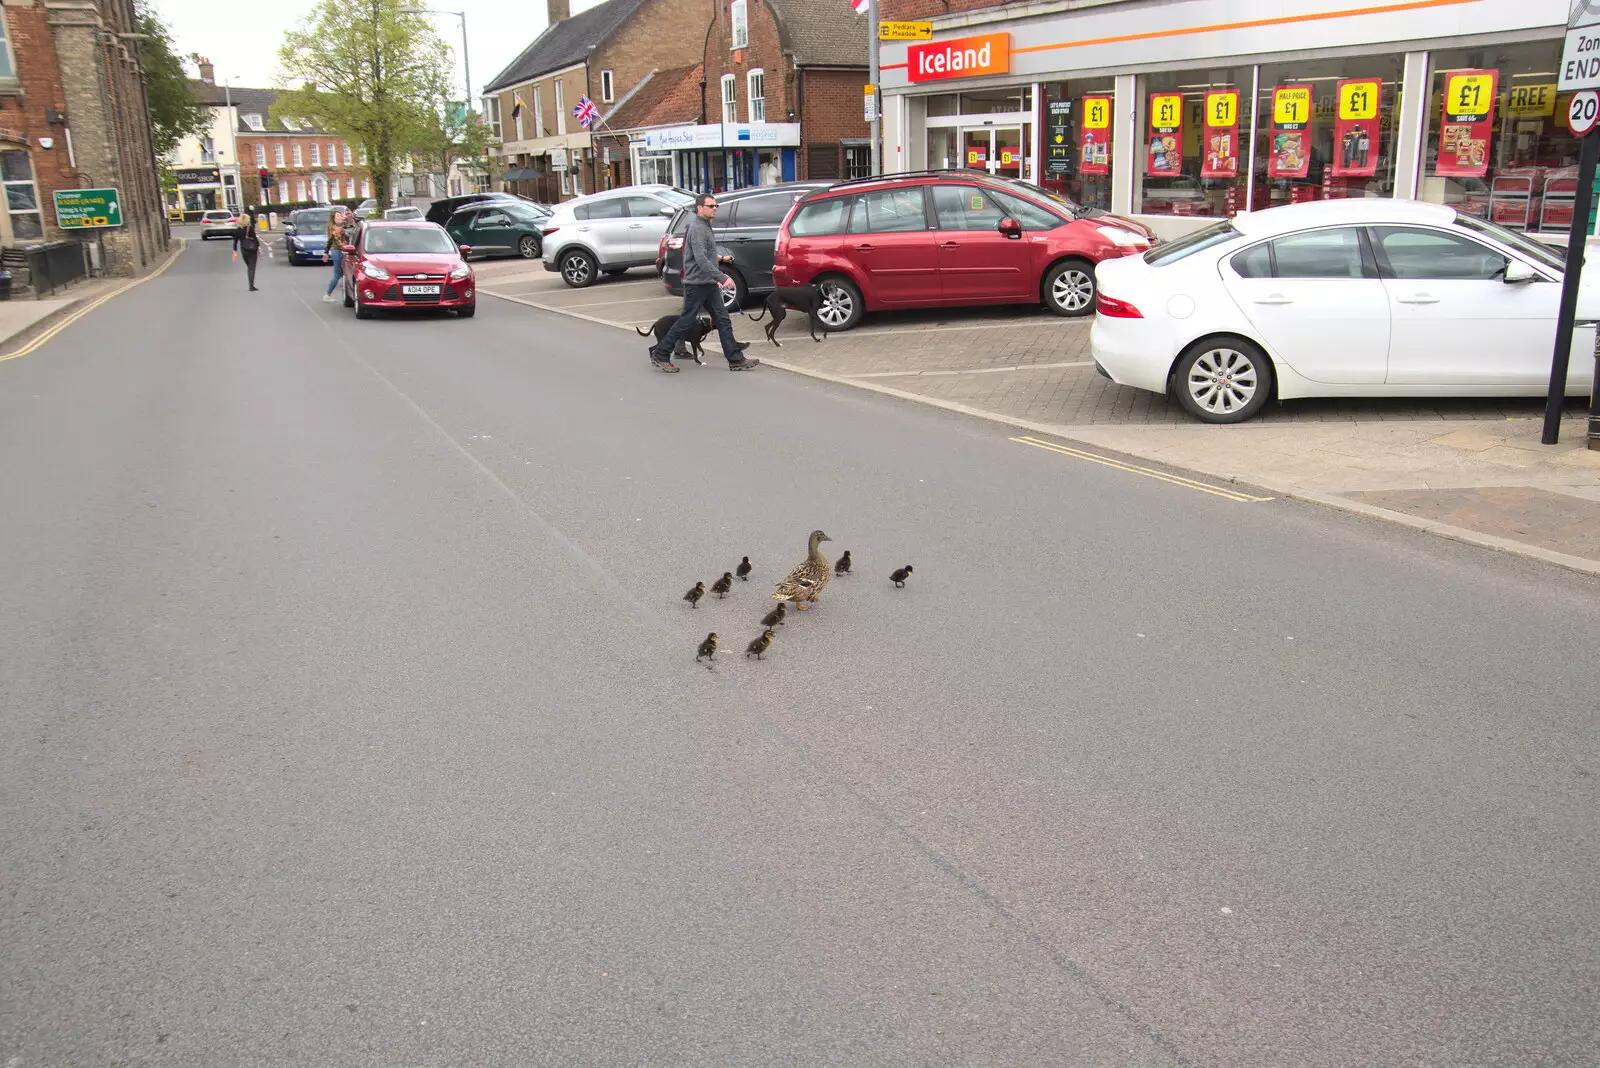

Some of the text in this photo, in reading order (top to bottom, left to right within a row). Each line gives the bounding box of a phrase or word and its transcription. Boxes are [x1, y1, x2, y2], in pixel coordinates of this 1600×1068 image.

[1578, 36, 1600, 52] Zon
[919, 41, 991, 74] Iceland
[1564, 57, 1600, 80] END
[1292, 91, 1306, 100] PRICE
[1350, 92, 1368, 112] £1
[1460, 84, 1480, 106] £1
[1508, 86, 1548, 106] FREE
[1092, 106, 1102, 122] £1
[1160, 104, 1173, 121] £1
[1216, 102, 1229, 120] £1
[1285, 102, 1297, 120] £1
[1572, 98, 1597, 120] 20
[668, 131, 682, 148] Hospice
[683, 131, 693, 145] Shop
